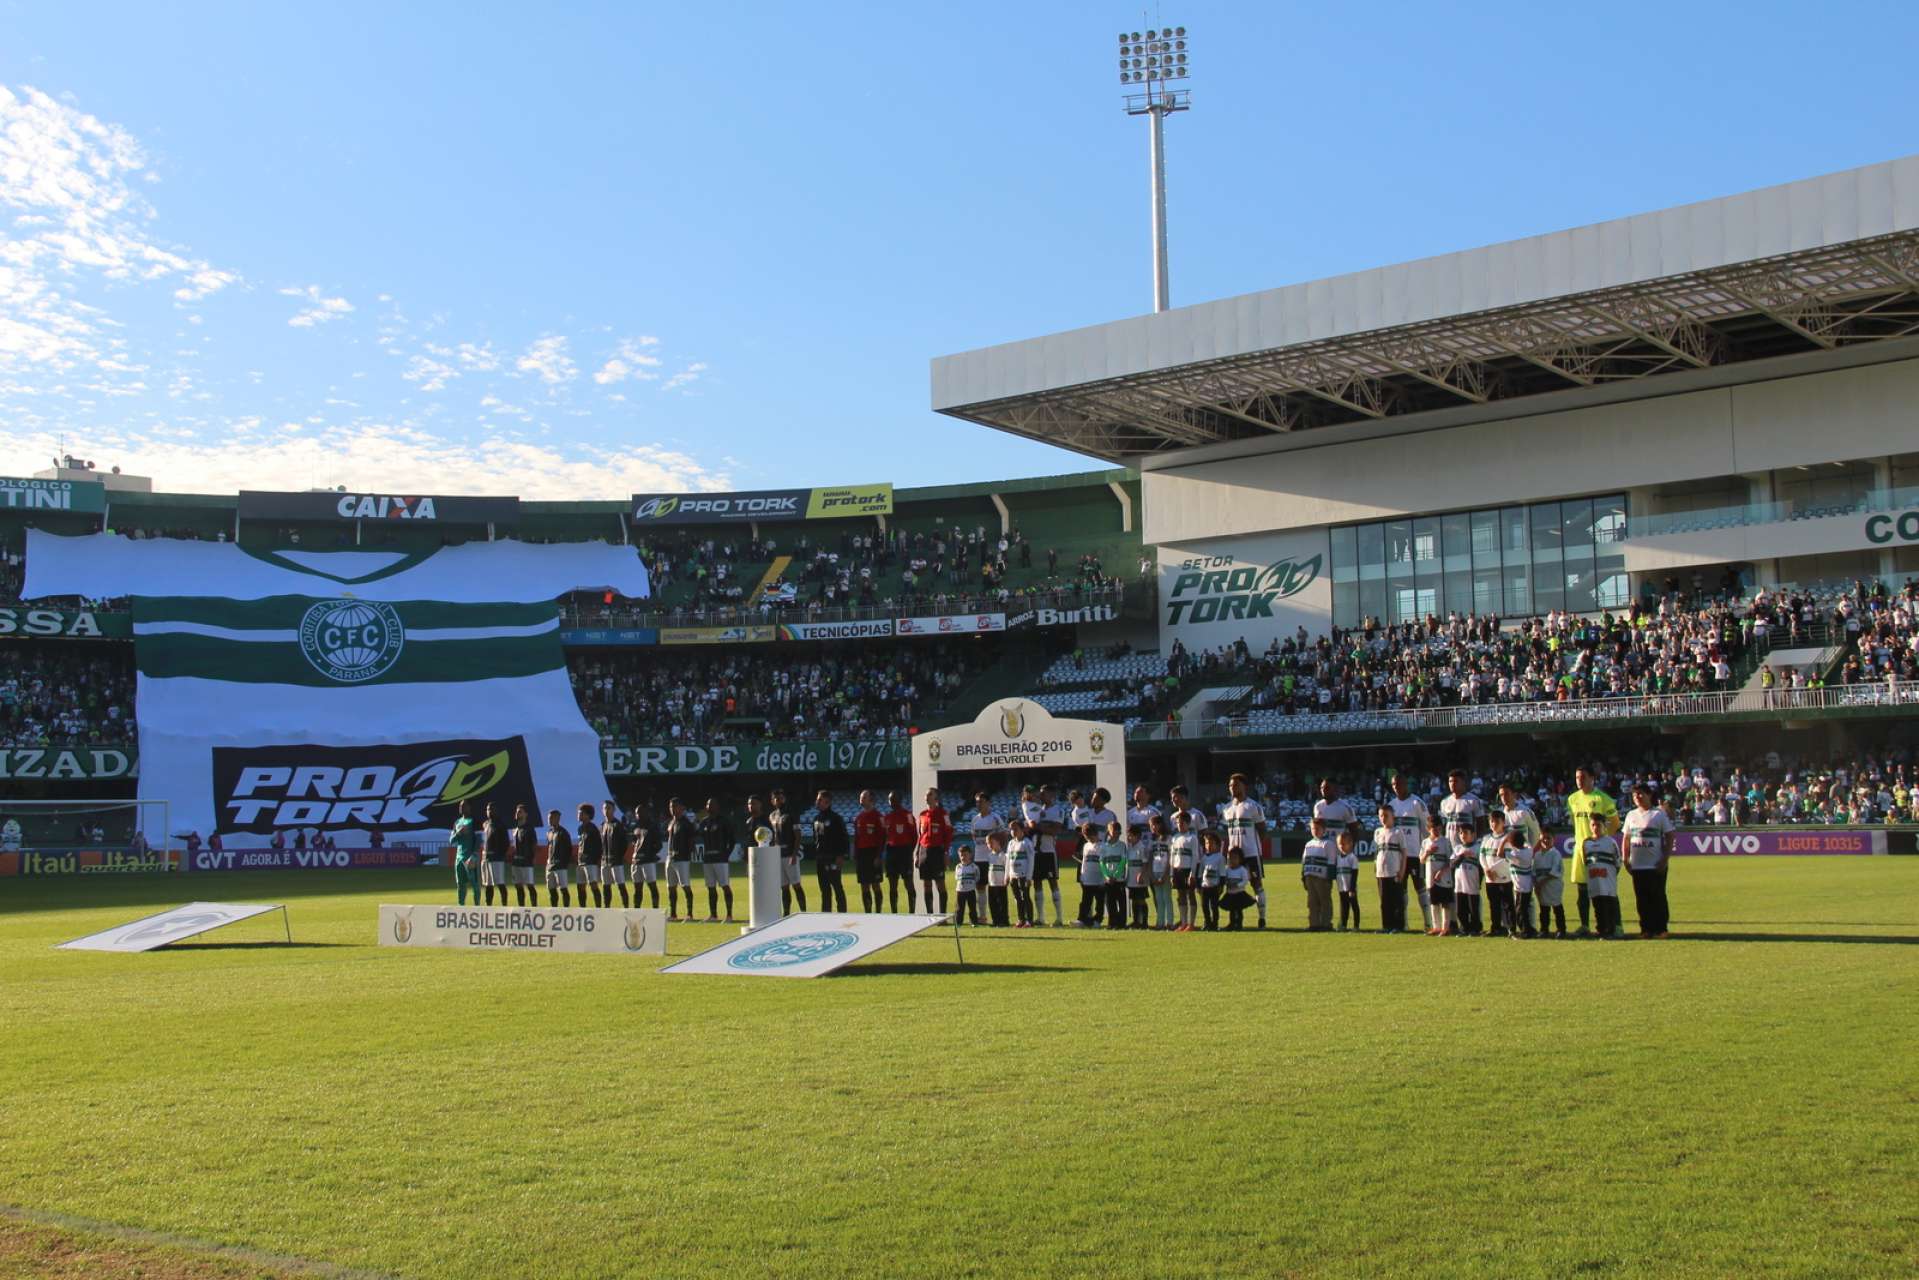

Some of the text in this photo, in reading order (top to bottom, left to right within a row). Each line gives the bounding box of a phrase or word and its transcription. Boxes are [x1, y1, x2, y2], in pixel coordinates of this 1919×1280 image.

[1, 487, 71, 510] TINI
[337, 495, 436, 519] CAIXA
[679, 497, 798, 513] PRO TORK
[822, 493, 886, 509] protork
[859, 504, 887, 512] .com
[1865, 511, 1919, 544] CO
[1182, 555, 1234, 571] SETOR
[1171, 567, 1258, 598] PRO
[1036, 604, 1119, 626] Buriti
[1167, 591, 1279, 625] TORK
[302, 605, 329, 651] CORITIBA
[387, 618, 400, 648] CLUB
[324, 625, 380, 649] CFC
[802, 622, 891, 639] TECNICÓPIAS
[604, 740, 887, 775] ERDE desde 1977
[956, 739, 1073, 756] BRASILEIRÃO 2016
[0, 750, 139, 779] IZAD
[983, 754, 1046, 765] CHEVROLET
[232, 766, 398, 799] PRO
[225, 799, 435, 826] TORK
[1692, 834, 1863, 854] VIVO LIGUE 10315
[23, 851, 76, 874] Itaú
[196, 851, 236, 869] GVT
[241, 853, 281, 866] AGORA
[282, 851, 291, 865] É
[296, 851, 350, 867] VIVO
[436, 910, 595, 932] BRASILEIRÃO 2016
[469, 932, 557, 948] CHEVROLET
